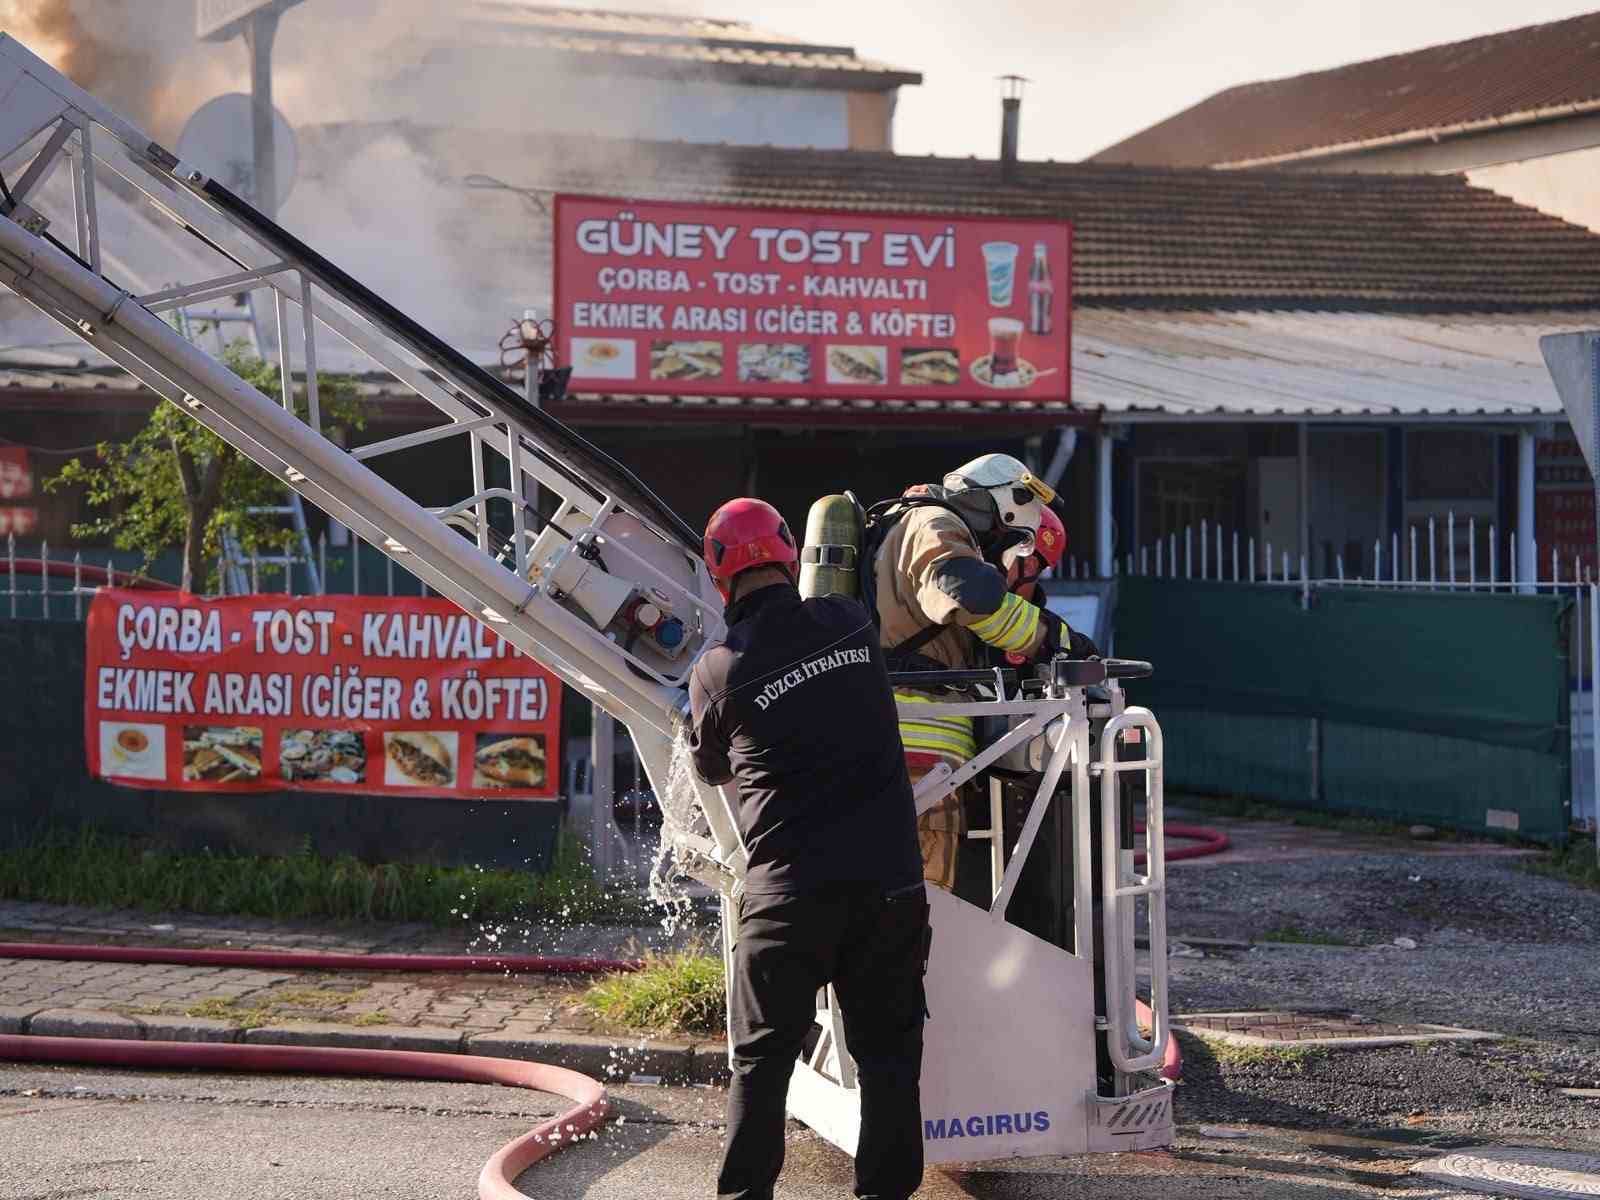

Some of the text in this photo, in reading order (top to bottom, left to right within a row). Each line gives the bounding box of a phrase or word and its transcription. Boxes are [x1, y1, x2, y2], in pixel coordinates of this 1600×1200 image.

[576, 212, 956, 269] GÜNEY TOST EVİ
[598, 267, 690, 295] ÇORBA
[713, 271, 781, 296] TOST
[803, 274, 927, 300] KAHVALTI
[573, 302, 956, 338] EKMEK ARASI (CİĞER & KÖFTE)
[117, 604, 221, 661] ÇORBA
[252, 609, 335, 655] TOST
[362, 612, 521, 659] KAHVAL
[97, 664, 548, 721] EKMEK ARASI (CİĞER & KÖFTE)
[753, 668, 805, 711] DÜZCE
[924, 1111, 1050, 1140] MAGIRUS
